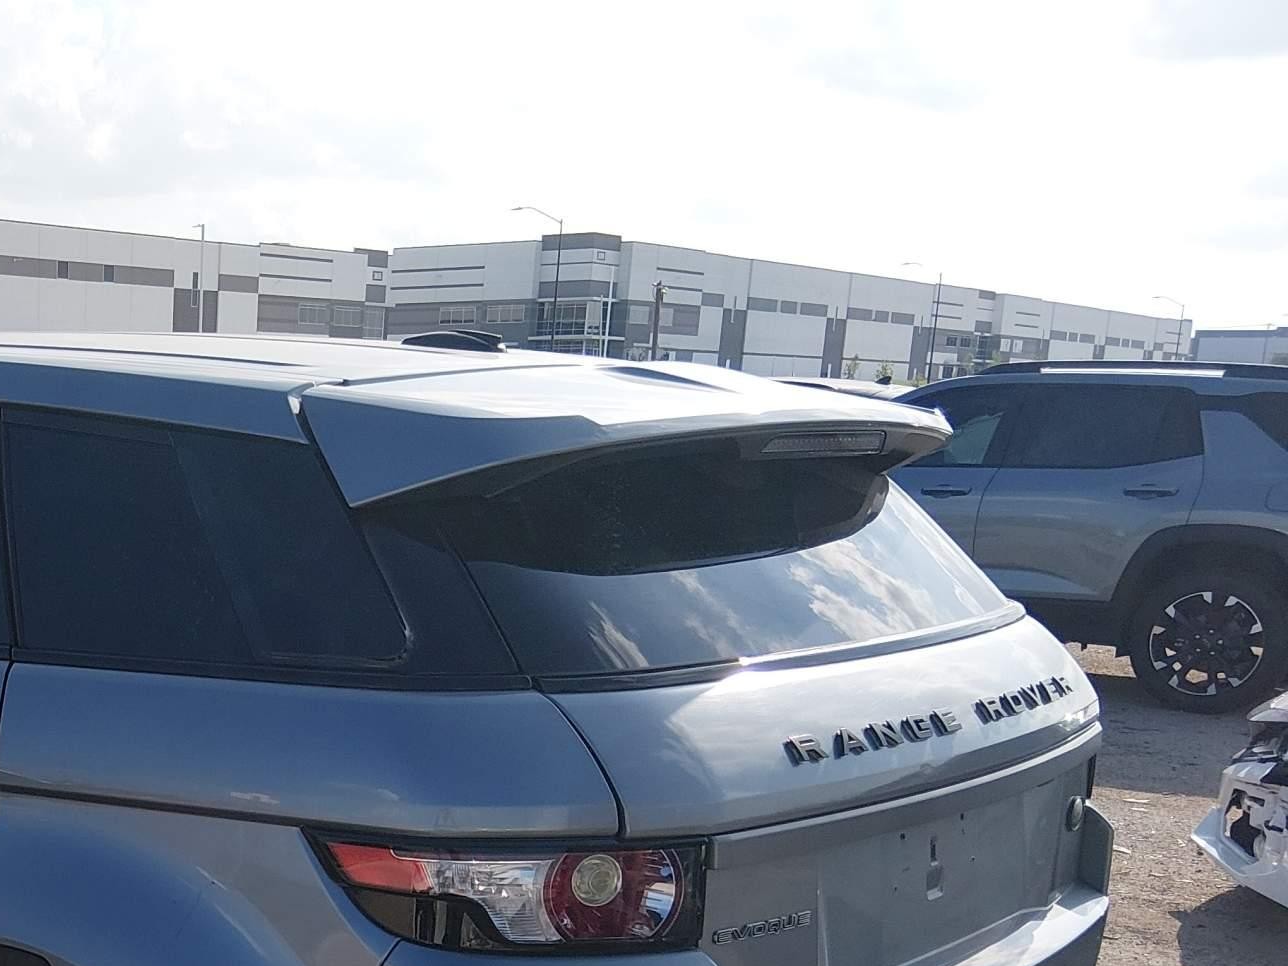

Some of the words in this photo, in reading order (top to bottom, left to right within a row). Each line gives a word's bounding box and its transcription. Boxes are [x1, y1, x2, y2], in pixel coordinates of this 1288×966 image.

[784, 707, 963, 766] RANGE
[973, 676, 1073, 725] ROVER
[712, 910, 811, 944] EVOQUE
